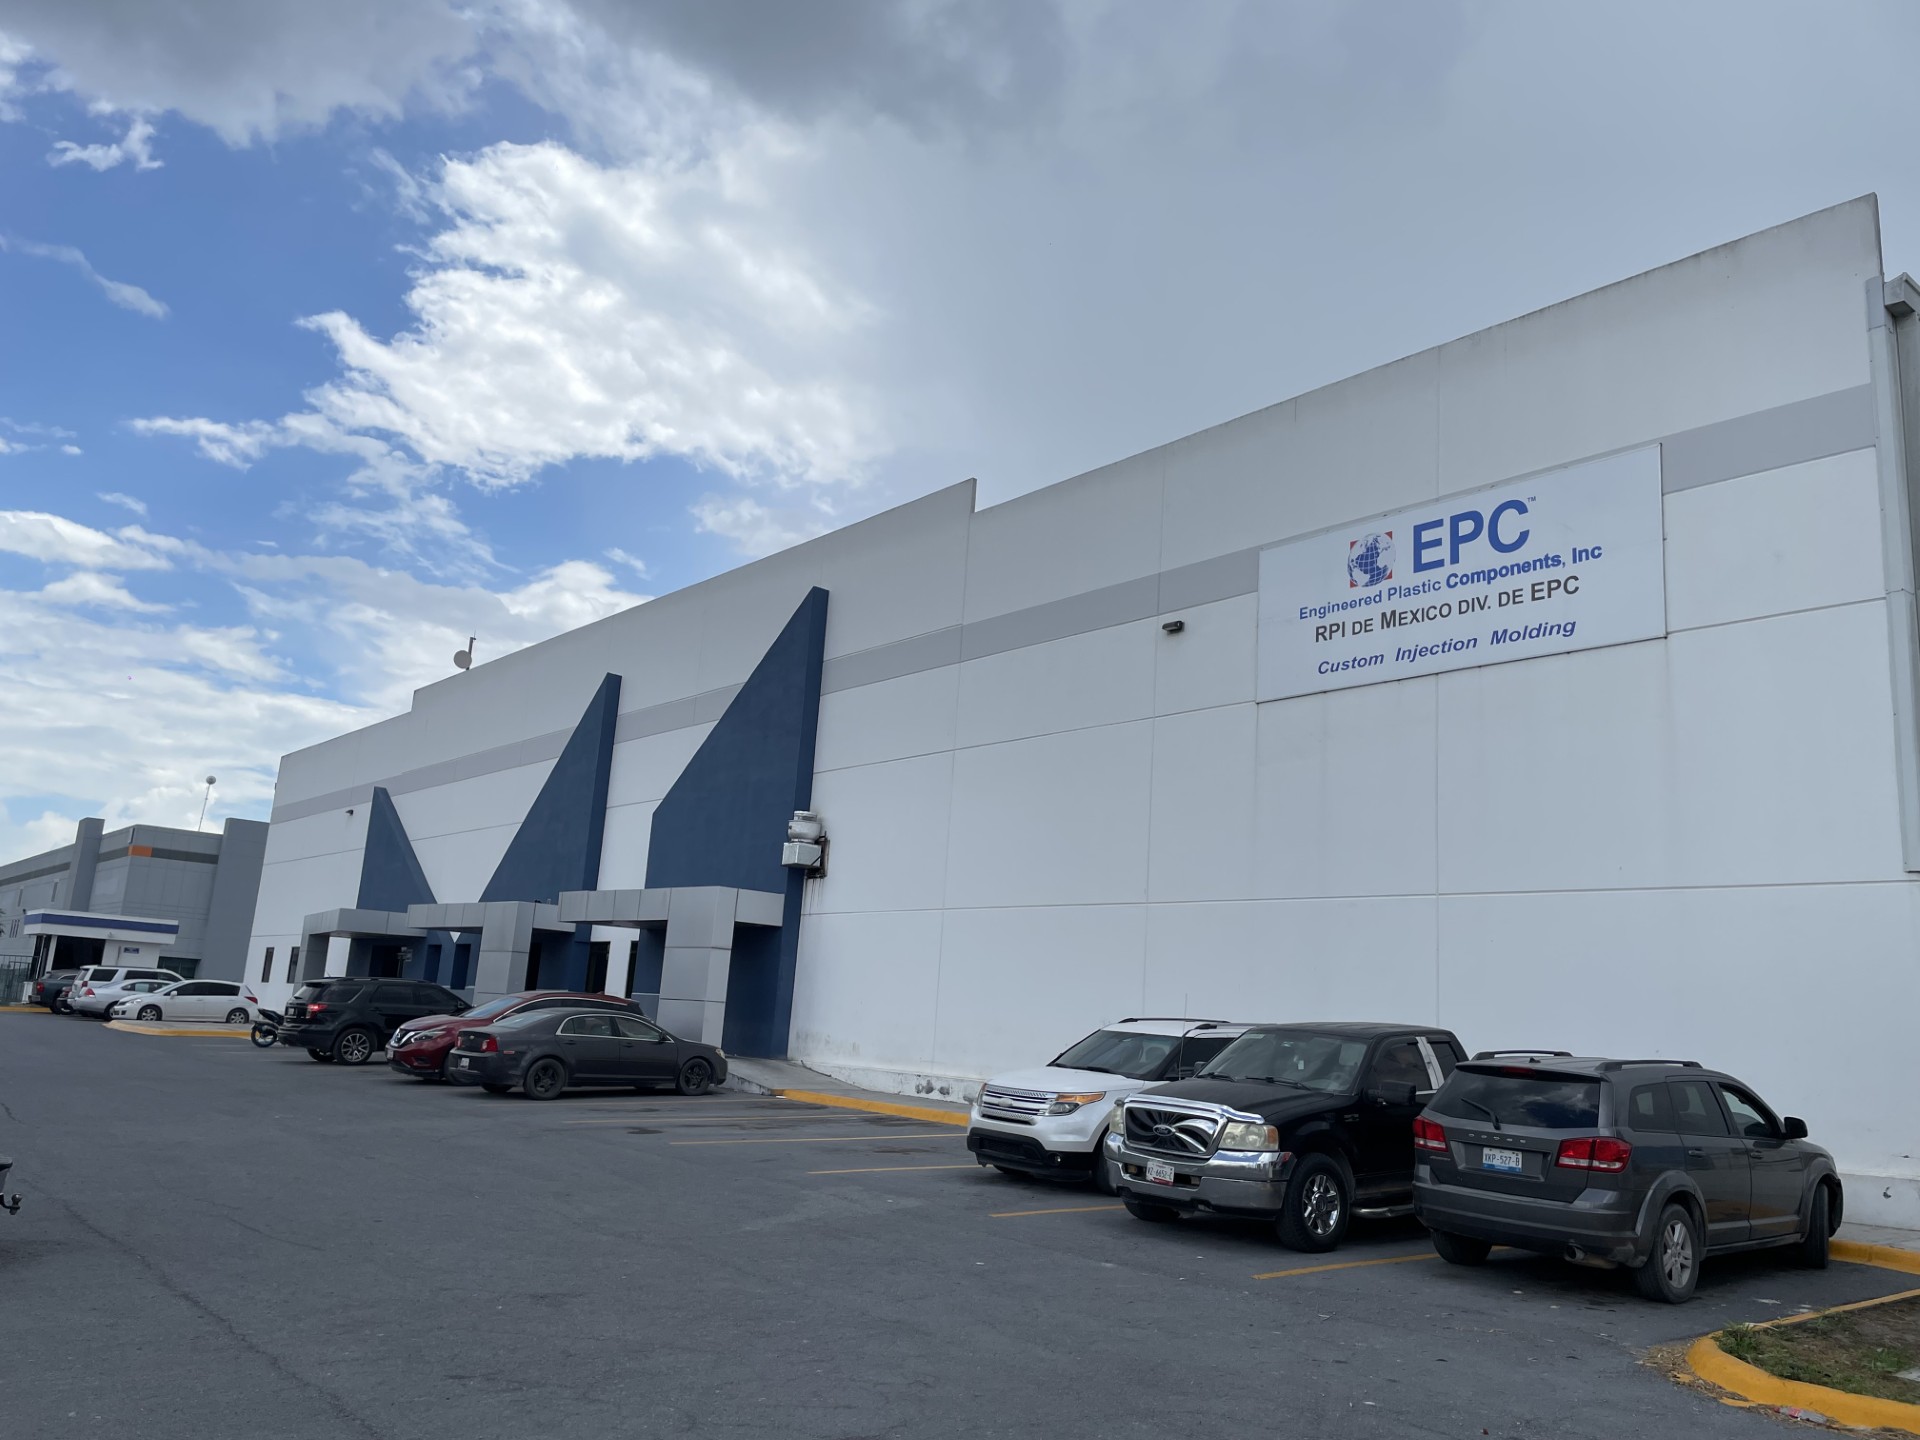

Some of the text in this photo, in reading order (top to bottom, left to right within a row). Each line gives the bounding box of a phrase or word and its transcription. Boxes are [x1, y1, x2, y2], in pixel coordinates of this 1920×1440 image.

[1413, 500, 1532, 574] EPC
[1299, 545, 1603, 621] Engineered Plastic Components, Inc
[1315, 575, 1580, 644] RPI DE MEXICO DIV. DE EPC
[1317, 620, 1577, 676] Custom Injection Molding
